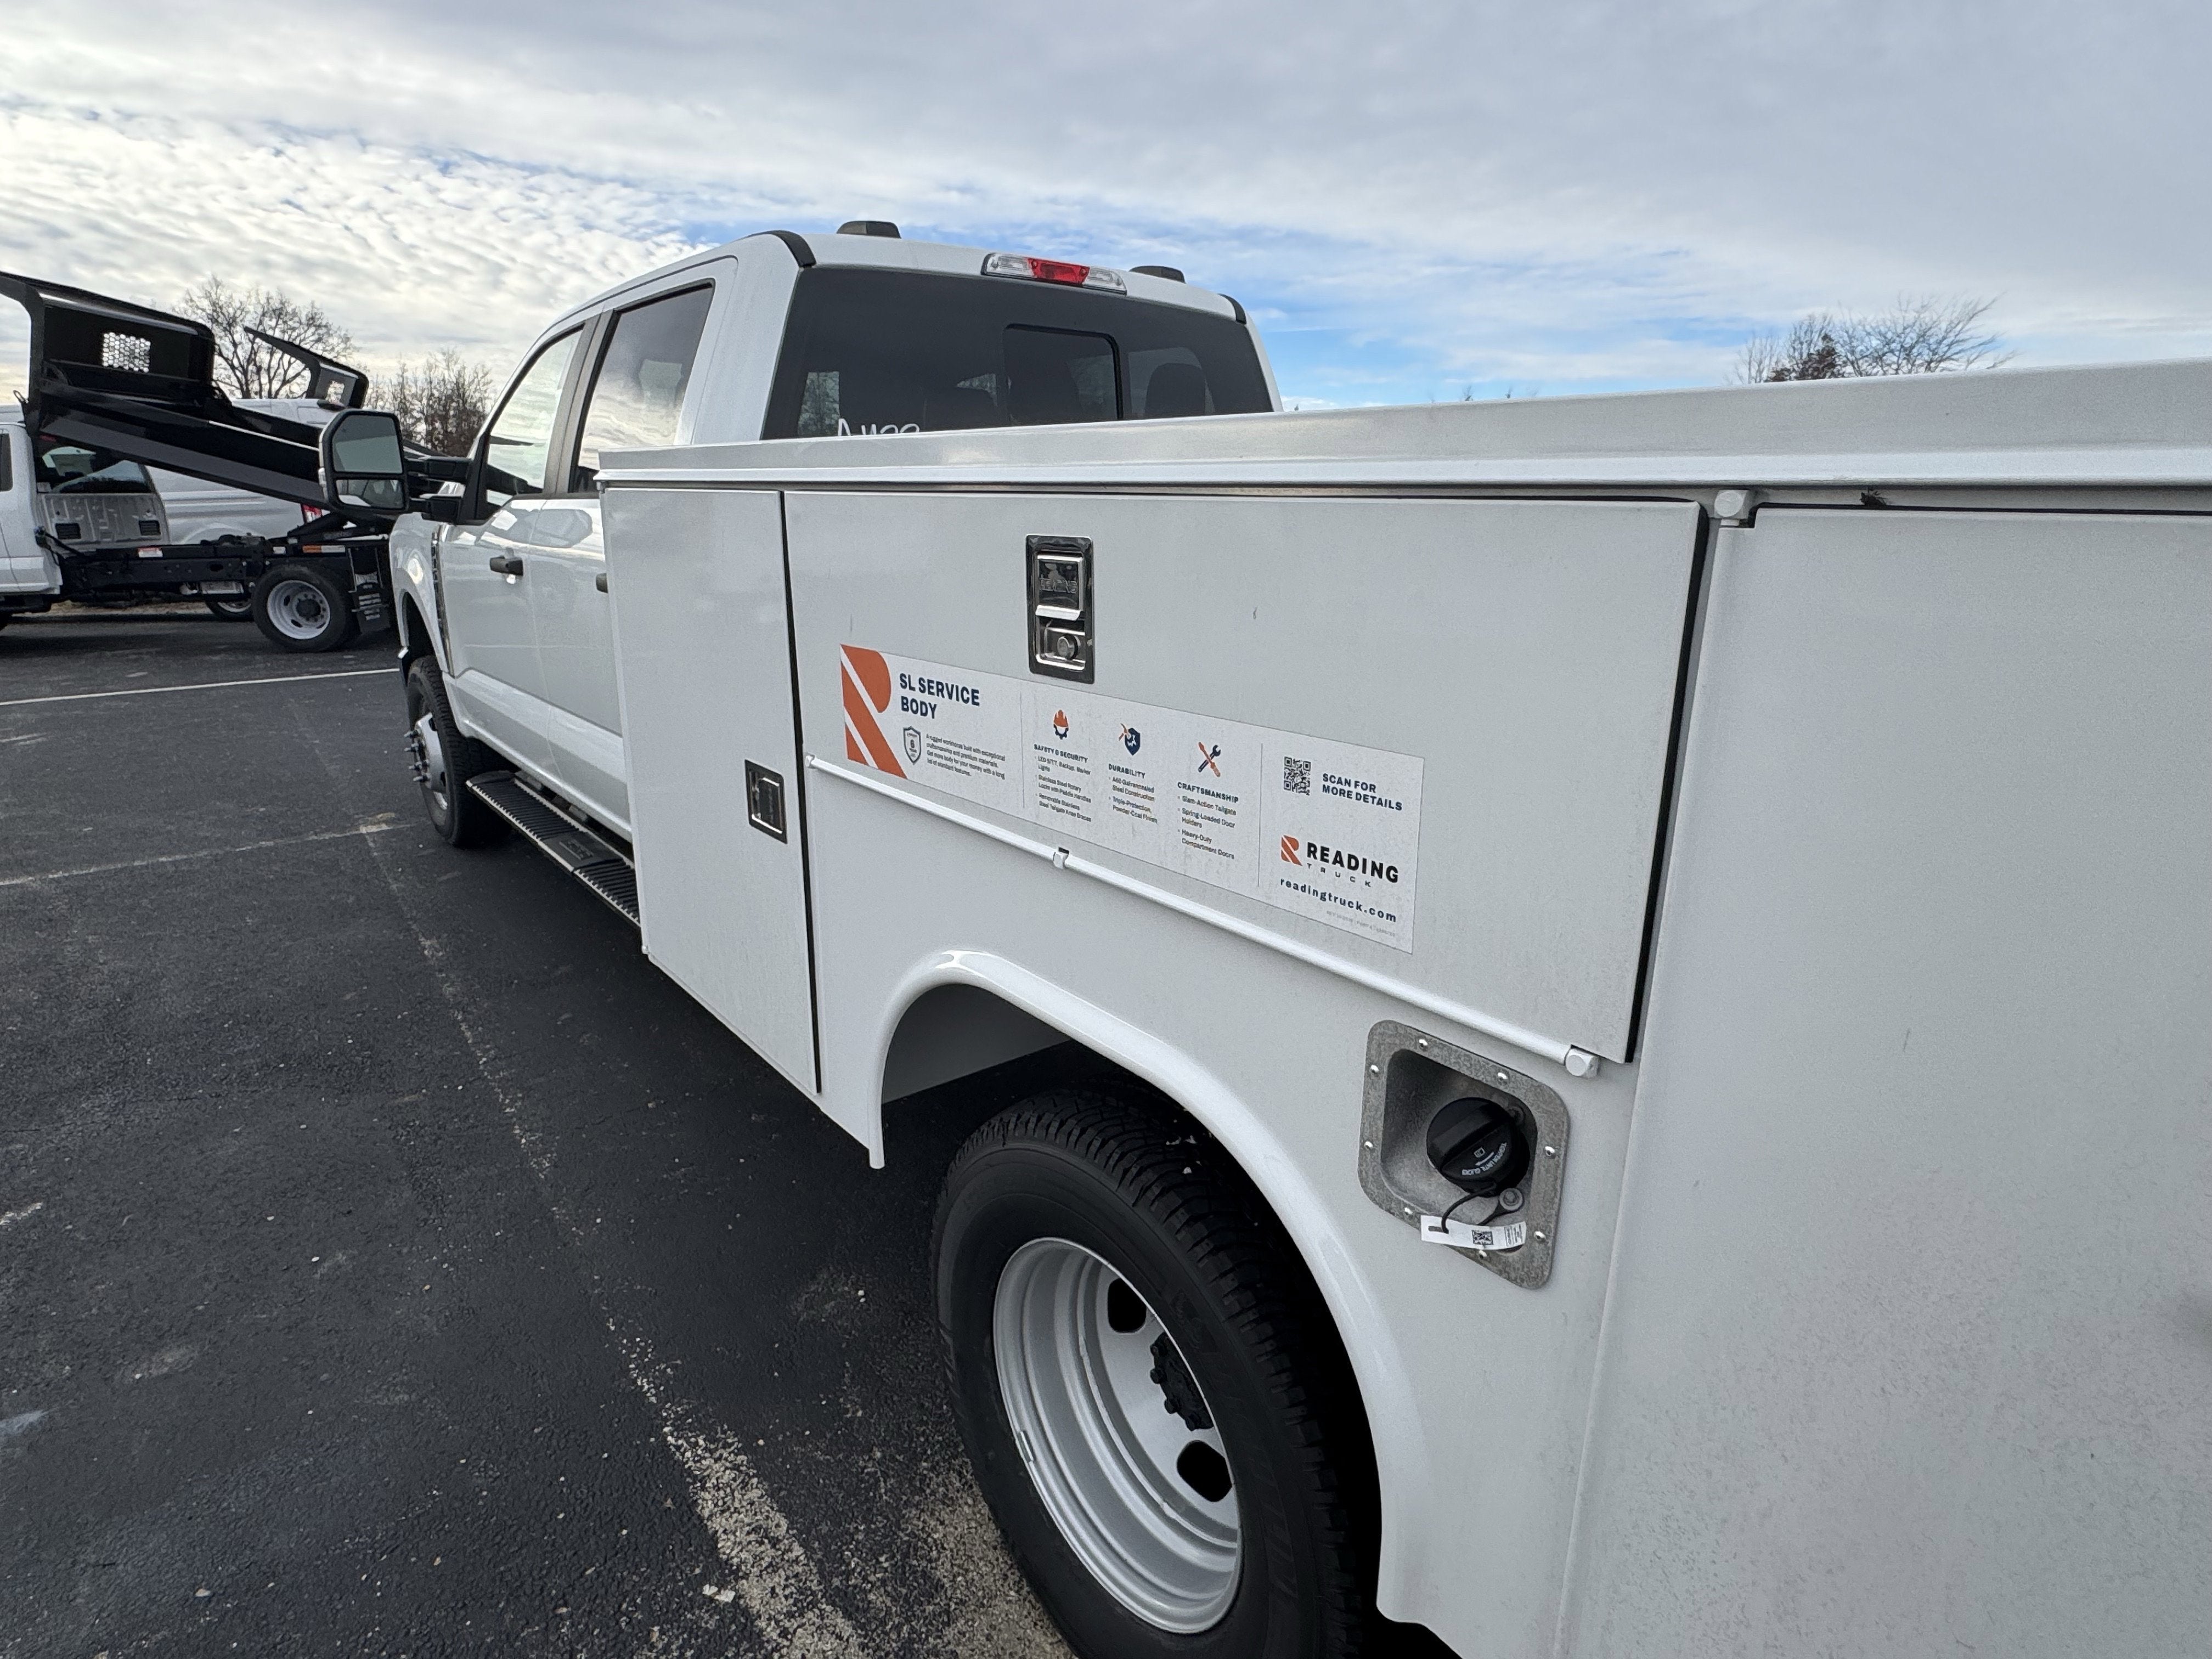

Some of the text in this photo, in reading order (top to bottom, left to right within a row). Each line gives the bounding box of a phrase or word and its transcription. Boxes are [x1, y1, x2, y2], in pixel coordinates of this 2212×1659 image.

[900, 673, 980, 707] SL SERVICE
[901, 696, 937, 719] BODY
[1034, 744, 1054, 753] SAFETY
[1060, 751, 1088, 763] SECURITY
[1108, 764, 1146, 778] DURABILITY
[1178, 782, 1238, 803] CRAFTSMANSHIP
[1322, 773, 1376, 793] SCAN FOR
[1125, 788, 1154, 802] Construction
[1322, 785, 1402, 811] MORE DETAILS
[1182, 808, 1235, 828] Spring-Loaded Door
[1215, 804, 1236, 815] Tailgate
[1182, 817, 1202, 828] Holders
[1182, 829, 1212, 844] Heavy-Duty
[1182, 838, 1234, 859] Compartment Doors
[1307, 842, 1398, 883] READING
[1307, 863, 1371, 887] TRUCK
[1280, 878, 1396, 923] readingtruck.com
